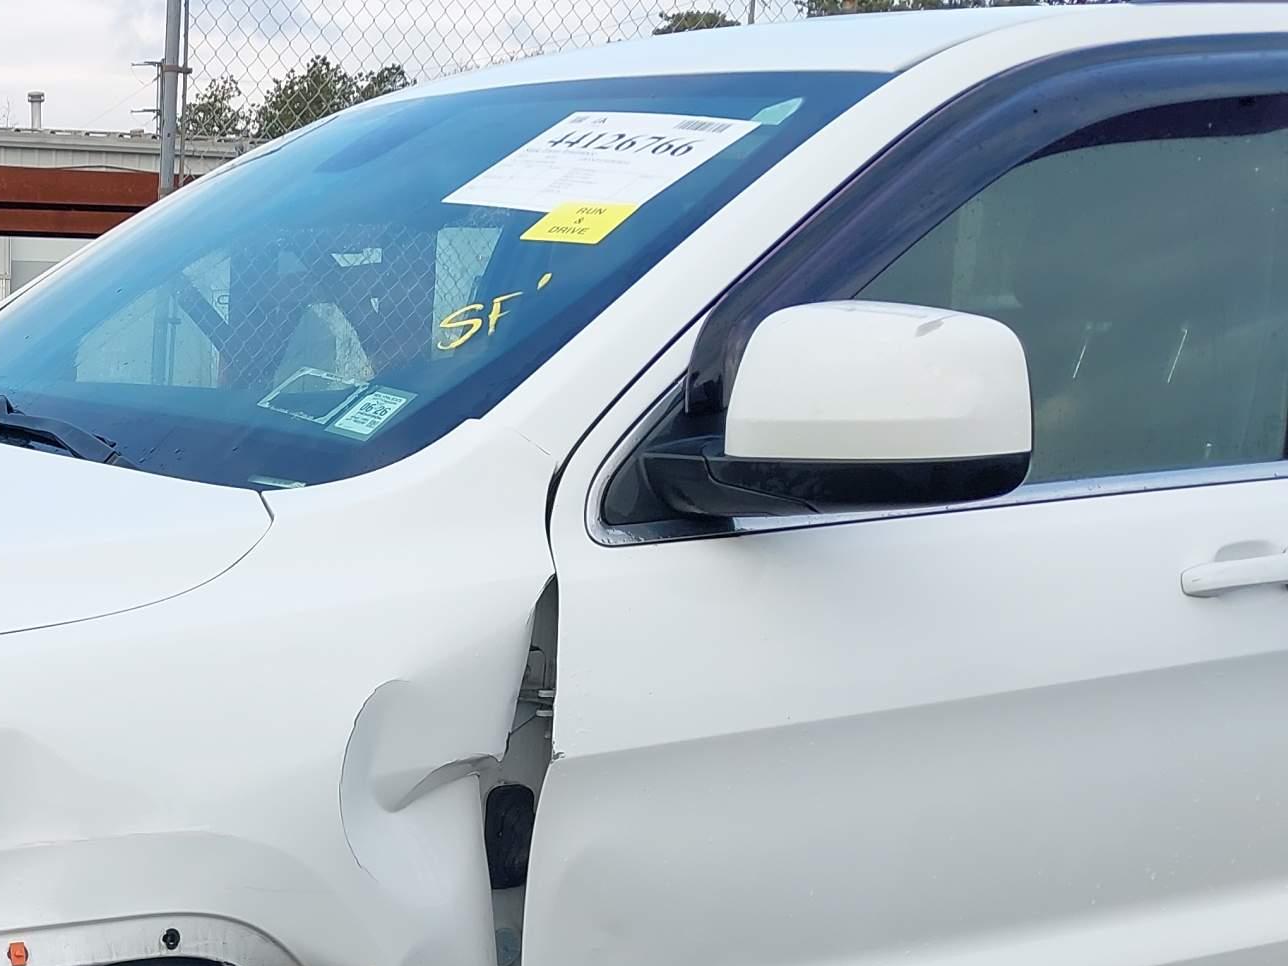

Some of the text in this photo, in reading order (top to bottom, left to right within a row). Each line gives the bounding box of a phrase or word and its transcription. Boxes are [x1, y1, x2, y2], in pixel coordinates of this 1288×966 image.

[548, 131, 704, 157] 44126766
[576, 207, 608, 215] RUN
[573, 217, 584, 225] &
[548, 225, 589, 235] DRIVE
